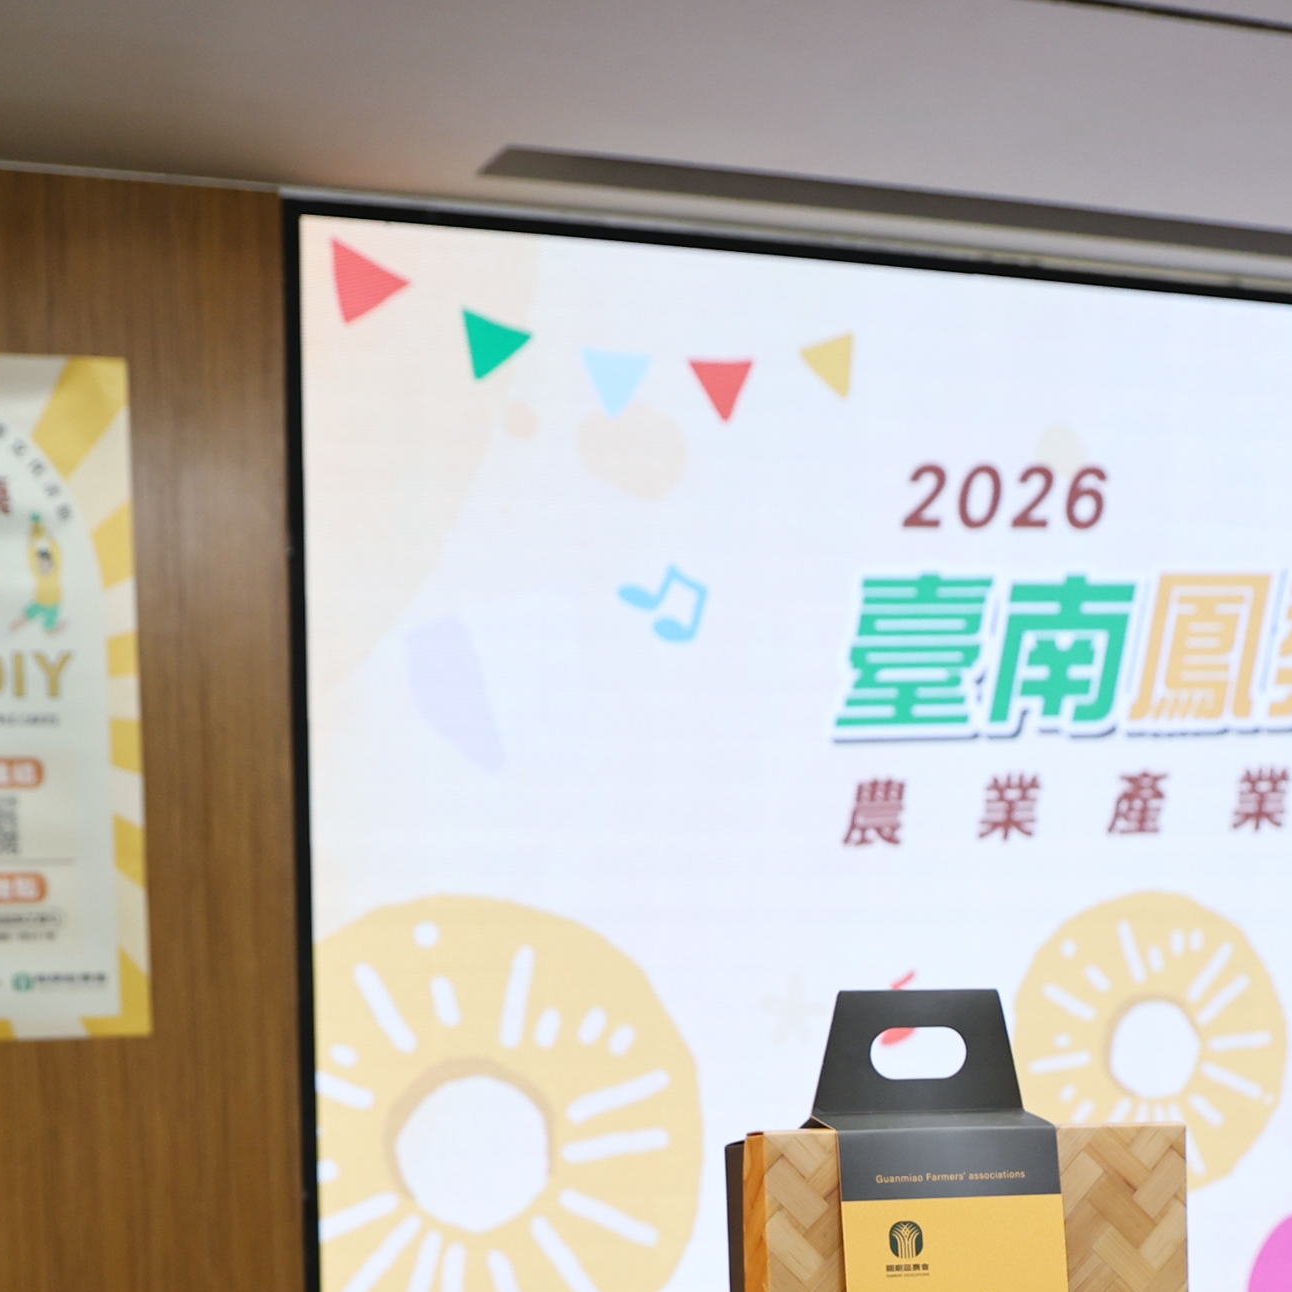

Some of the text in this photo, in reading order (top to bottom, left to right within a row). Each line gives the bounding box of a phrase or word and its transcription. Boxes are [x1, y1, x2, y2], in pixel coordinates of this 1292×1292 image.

[901, 463, 1110, 530] 2026
[875, 1170, 1026, 1184] Guanmiao Farmers' associations
